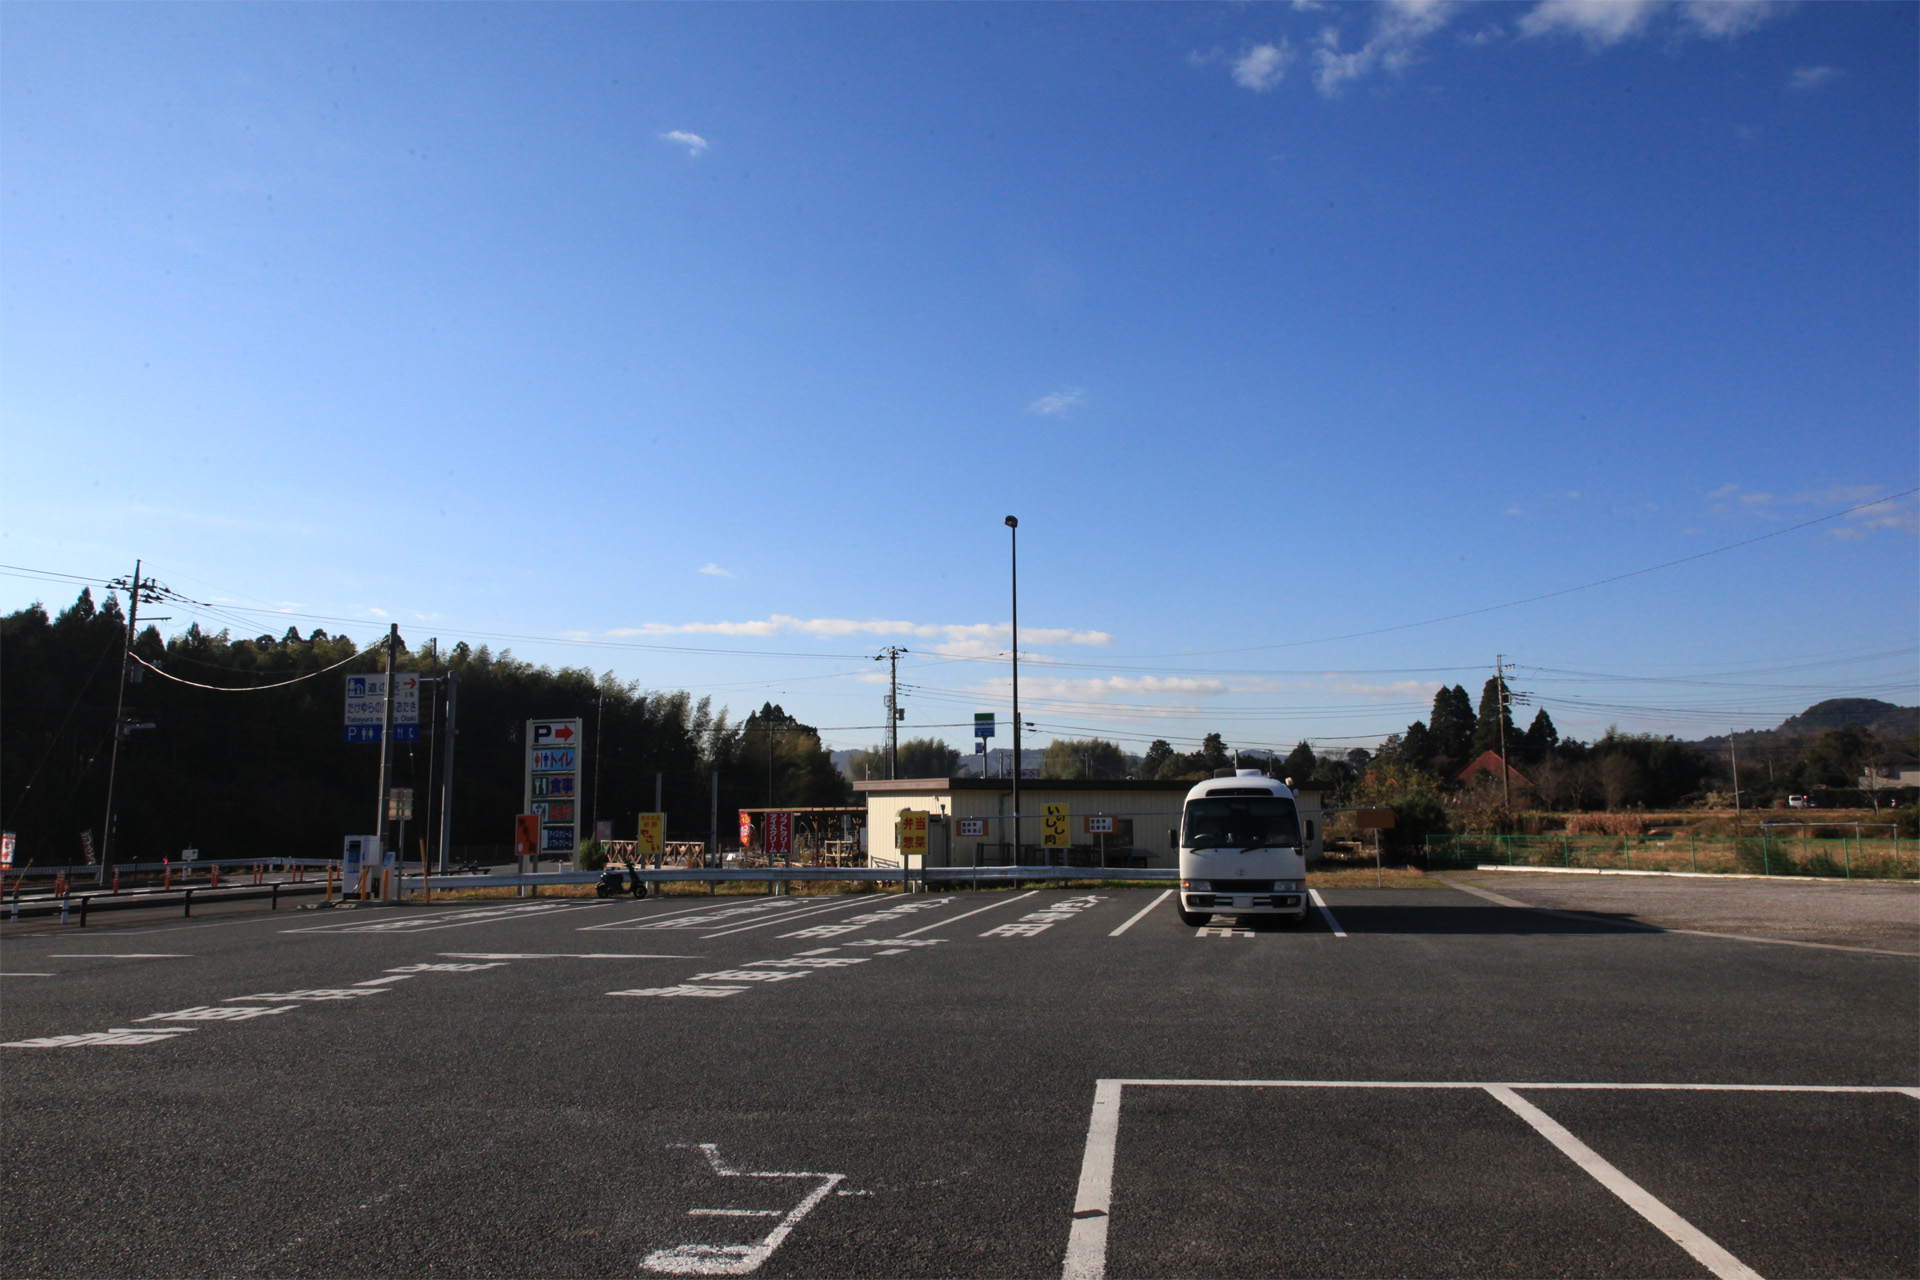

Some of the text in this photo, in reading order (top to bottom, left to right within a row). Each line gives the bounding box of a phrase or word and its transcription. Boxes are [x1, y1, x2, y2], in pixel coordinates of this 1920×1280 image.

[347, 702, 417, 714] たけゆらのおたき
[534, 725, 552, 743] P
[550, 751, 574, 768] トイレ
[549, 777, 574, 794] 食事
[903, 816, 926, 831] 弁当
[548, 830, 573, 838] アイスクリーム
[640, 829, 660, 852] やさい
[769, 814, 778, 853] アイスクリーム
[779, 813, 788, 853] ソフトクリーム
[548, 839, 573, 847] ソフトクリーム
[903, 836, 926, 849] 惣菜
